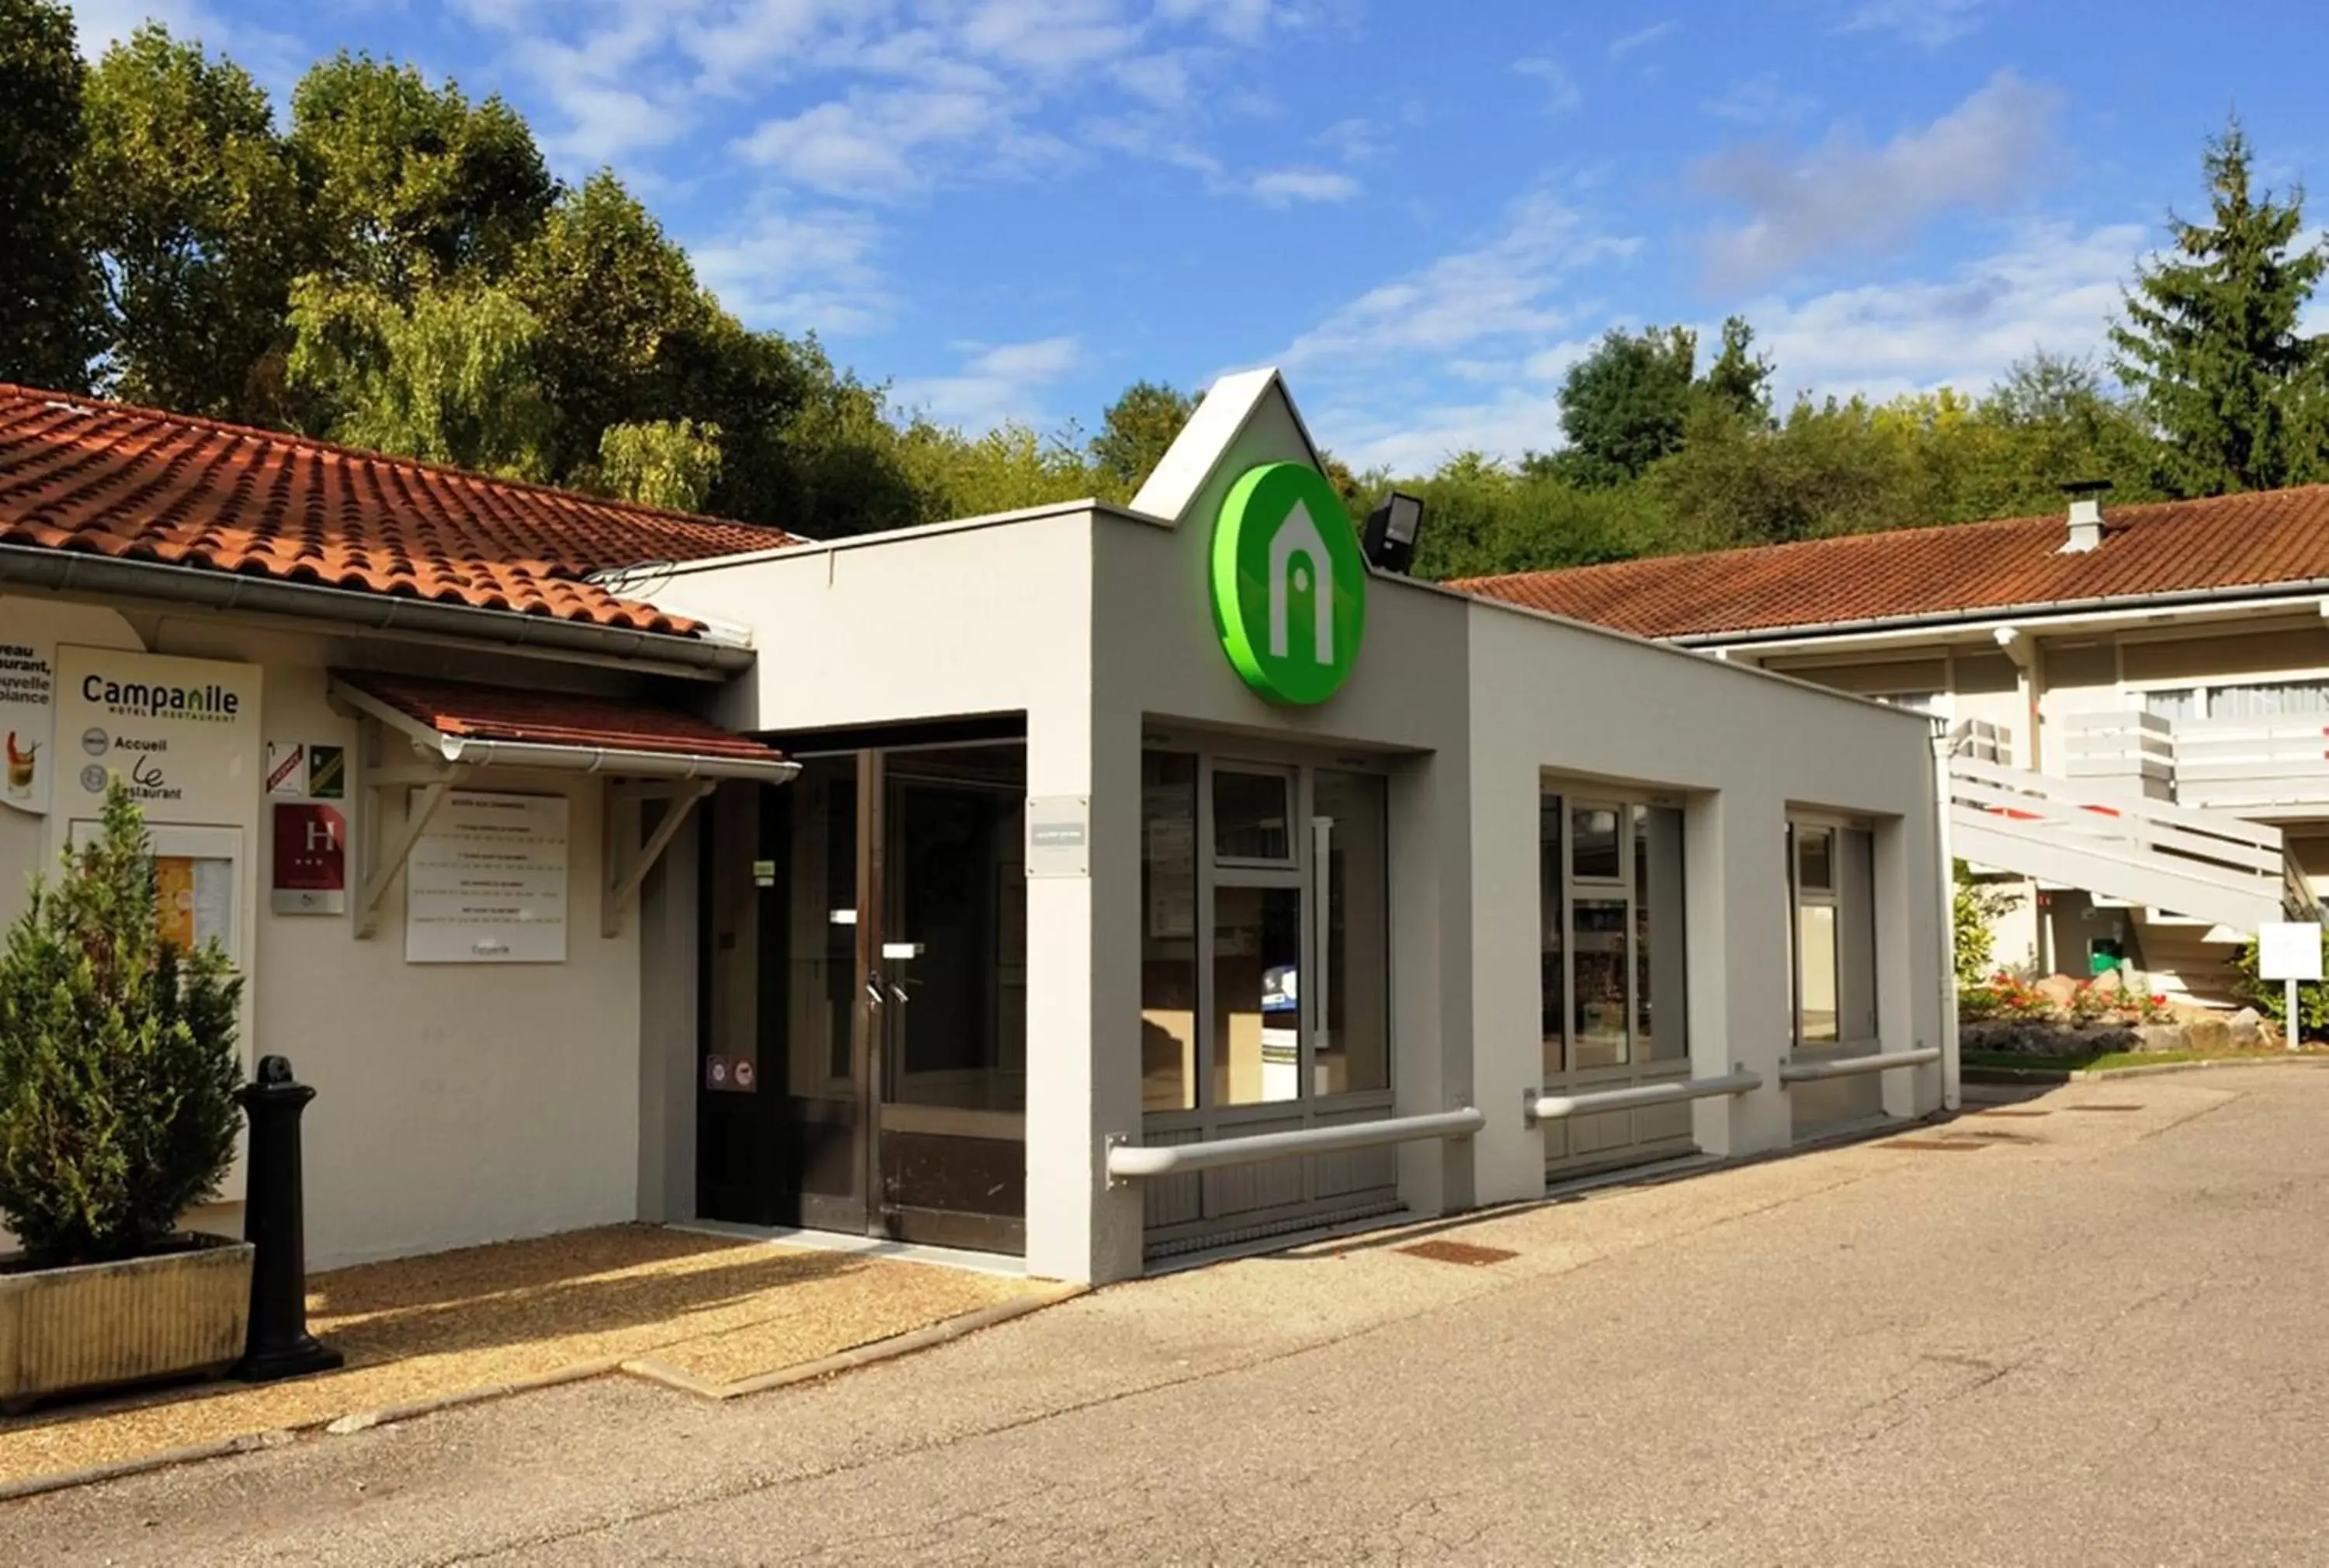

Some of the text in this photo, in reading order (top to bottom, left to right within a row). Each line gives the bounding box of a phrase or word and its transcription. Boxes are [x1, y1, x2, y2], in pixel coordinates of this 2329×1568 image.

[82, 674, 238, 716] Campanile
[115, 737, 167, 751] Accueil
[122, 786, 182, 800] estaurant
[307, 821, 335, 851] H
